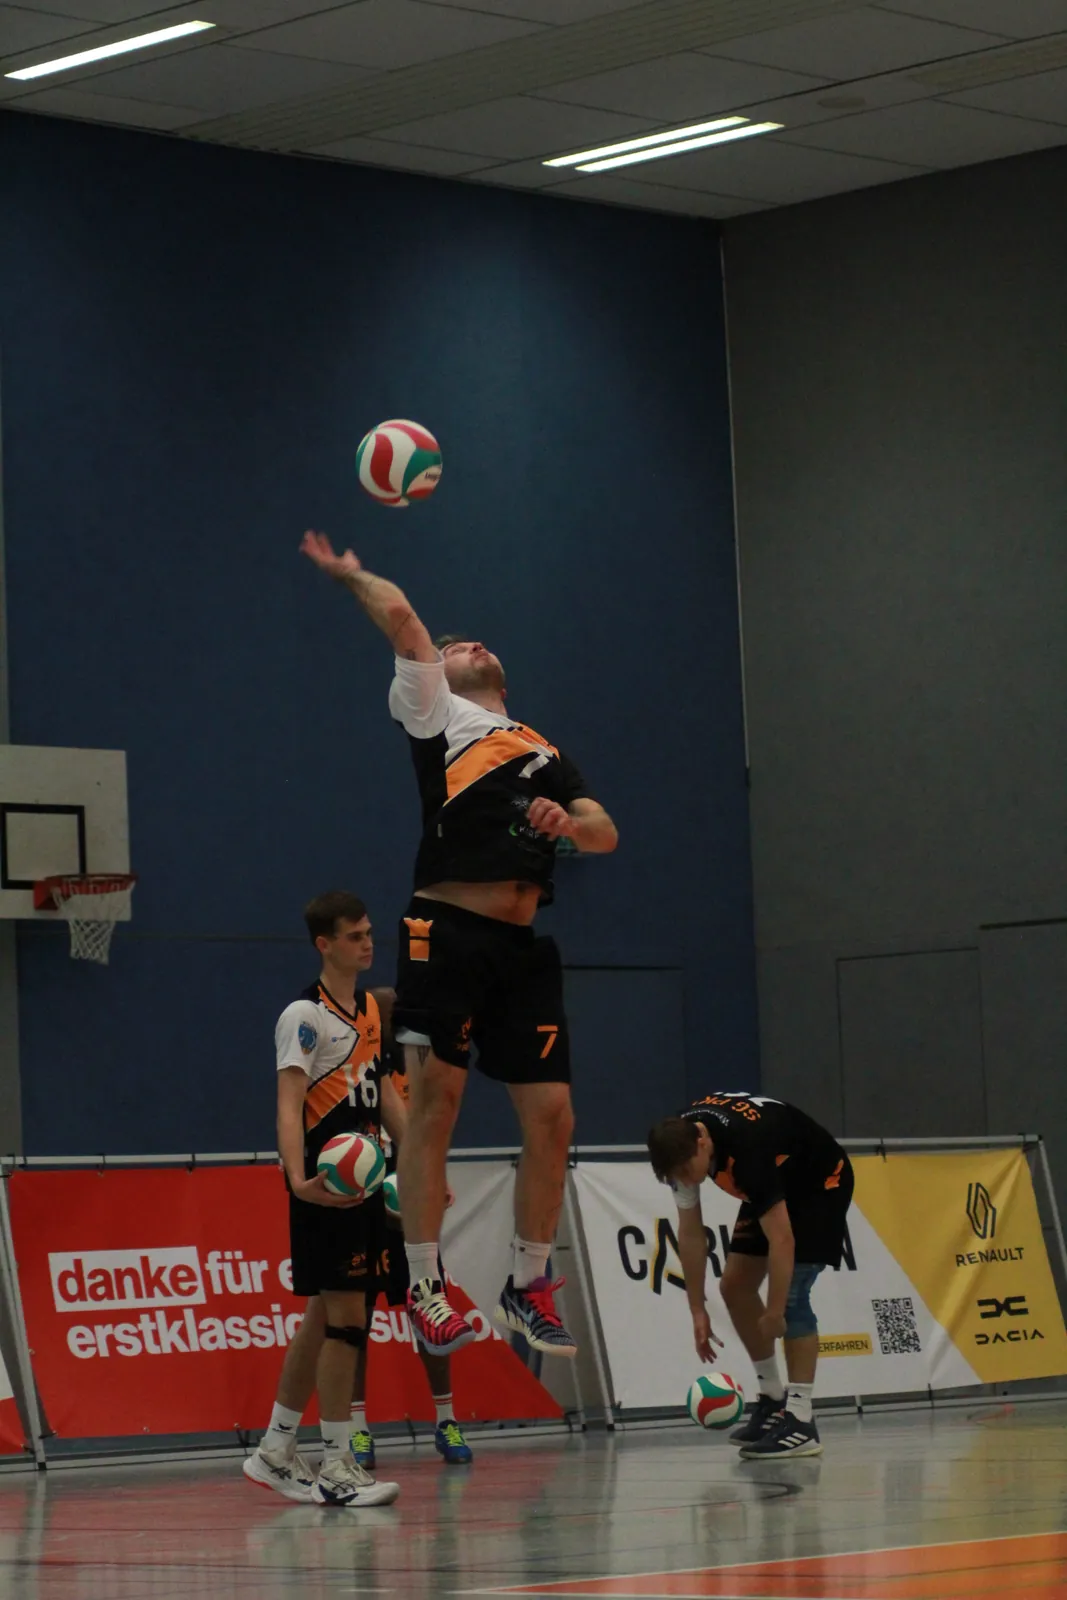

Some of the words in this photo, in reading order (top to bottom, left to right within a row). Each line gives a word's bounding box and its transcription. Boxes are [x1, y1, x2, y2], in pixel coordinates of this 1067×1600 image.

[536, 1024, 559, 1060] 7
[343, 1060, 379, 1109] 16
[955, 1247, 1024, 1268] RENAULT
[57, 1255, 199, 1303] danke
[204, 1250, 269, 1295] für
[66, 1303, 305, 1360] erstklassi
[817, 1339, 870, 1354] ERFAHREN
[974, 1329, 1045, 1346] DACIA
